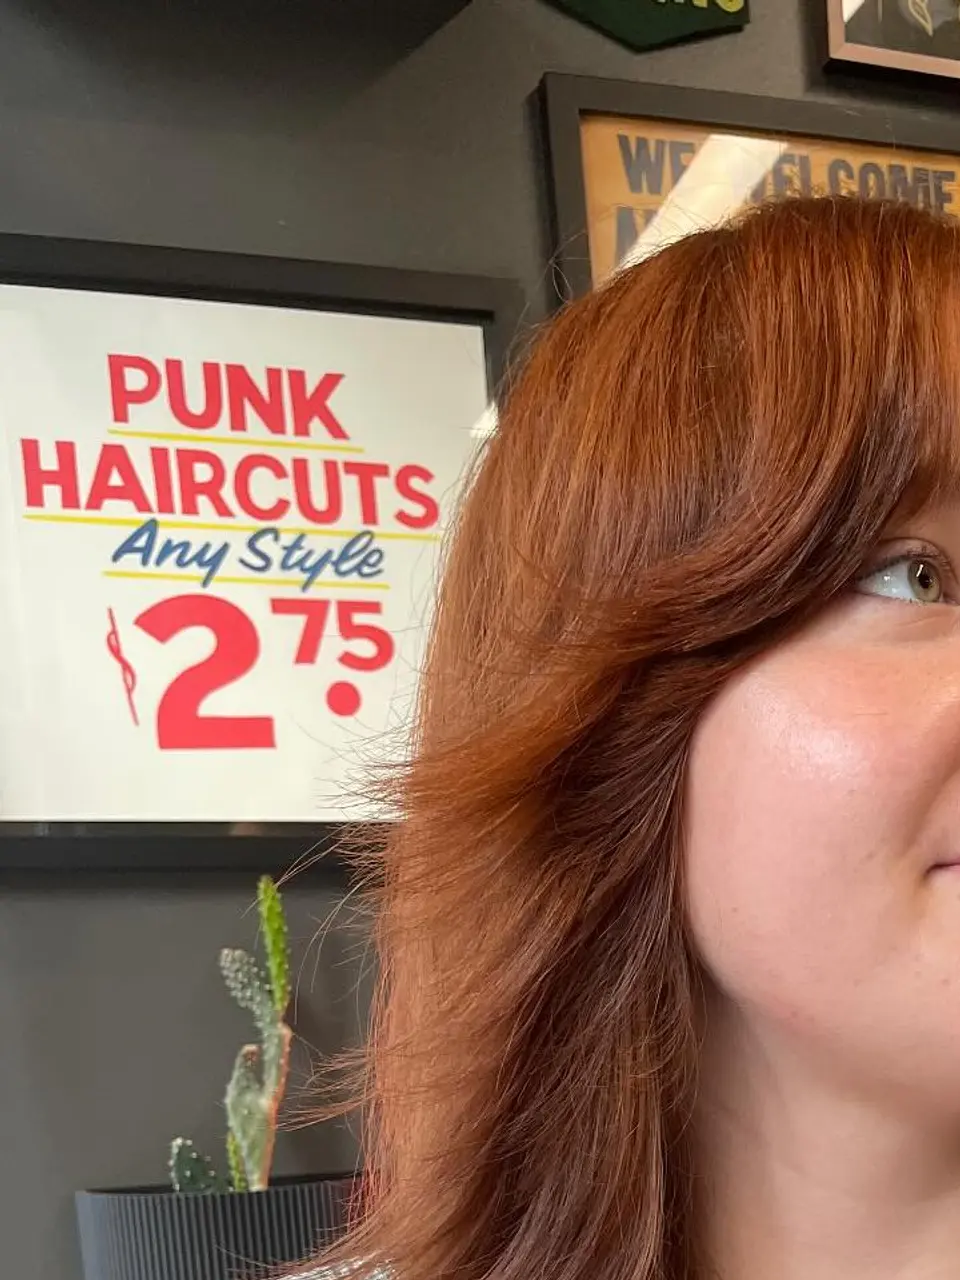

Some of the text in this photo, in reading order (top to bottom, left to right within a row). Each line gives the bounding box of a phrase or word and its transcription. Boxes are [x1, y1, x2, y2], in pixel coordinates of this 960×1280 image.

[617, 133, 698, 196] WE
[107, 353, 351, 441] PUNK
[20, 437, 440, 530] HAIRCUTS
[111, 518, 386, 593] Any Style
